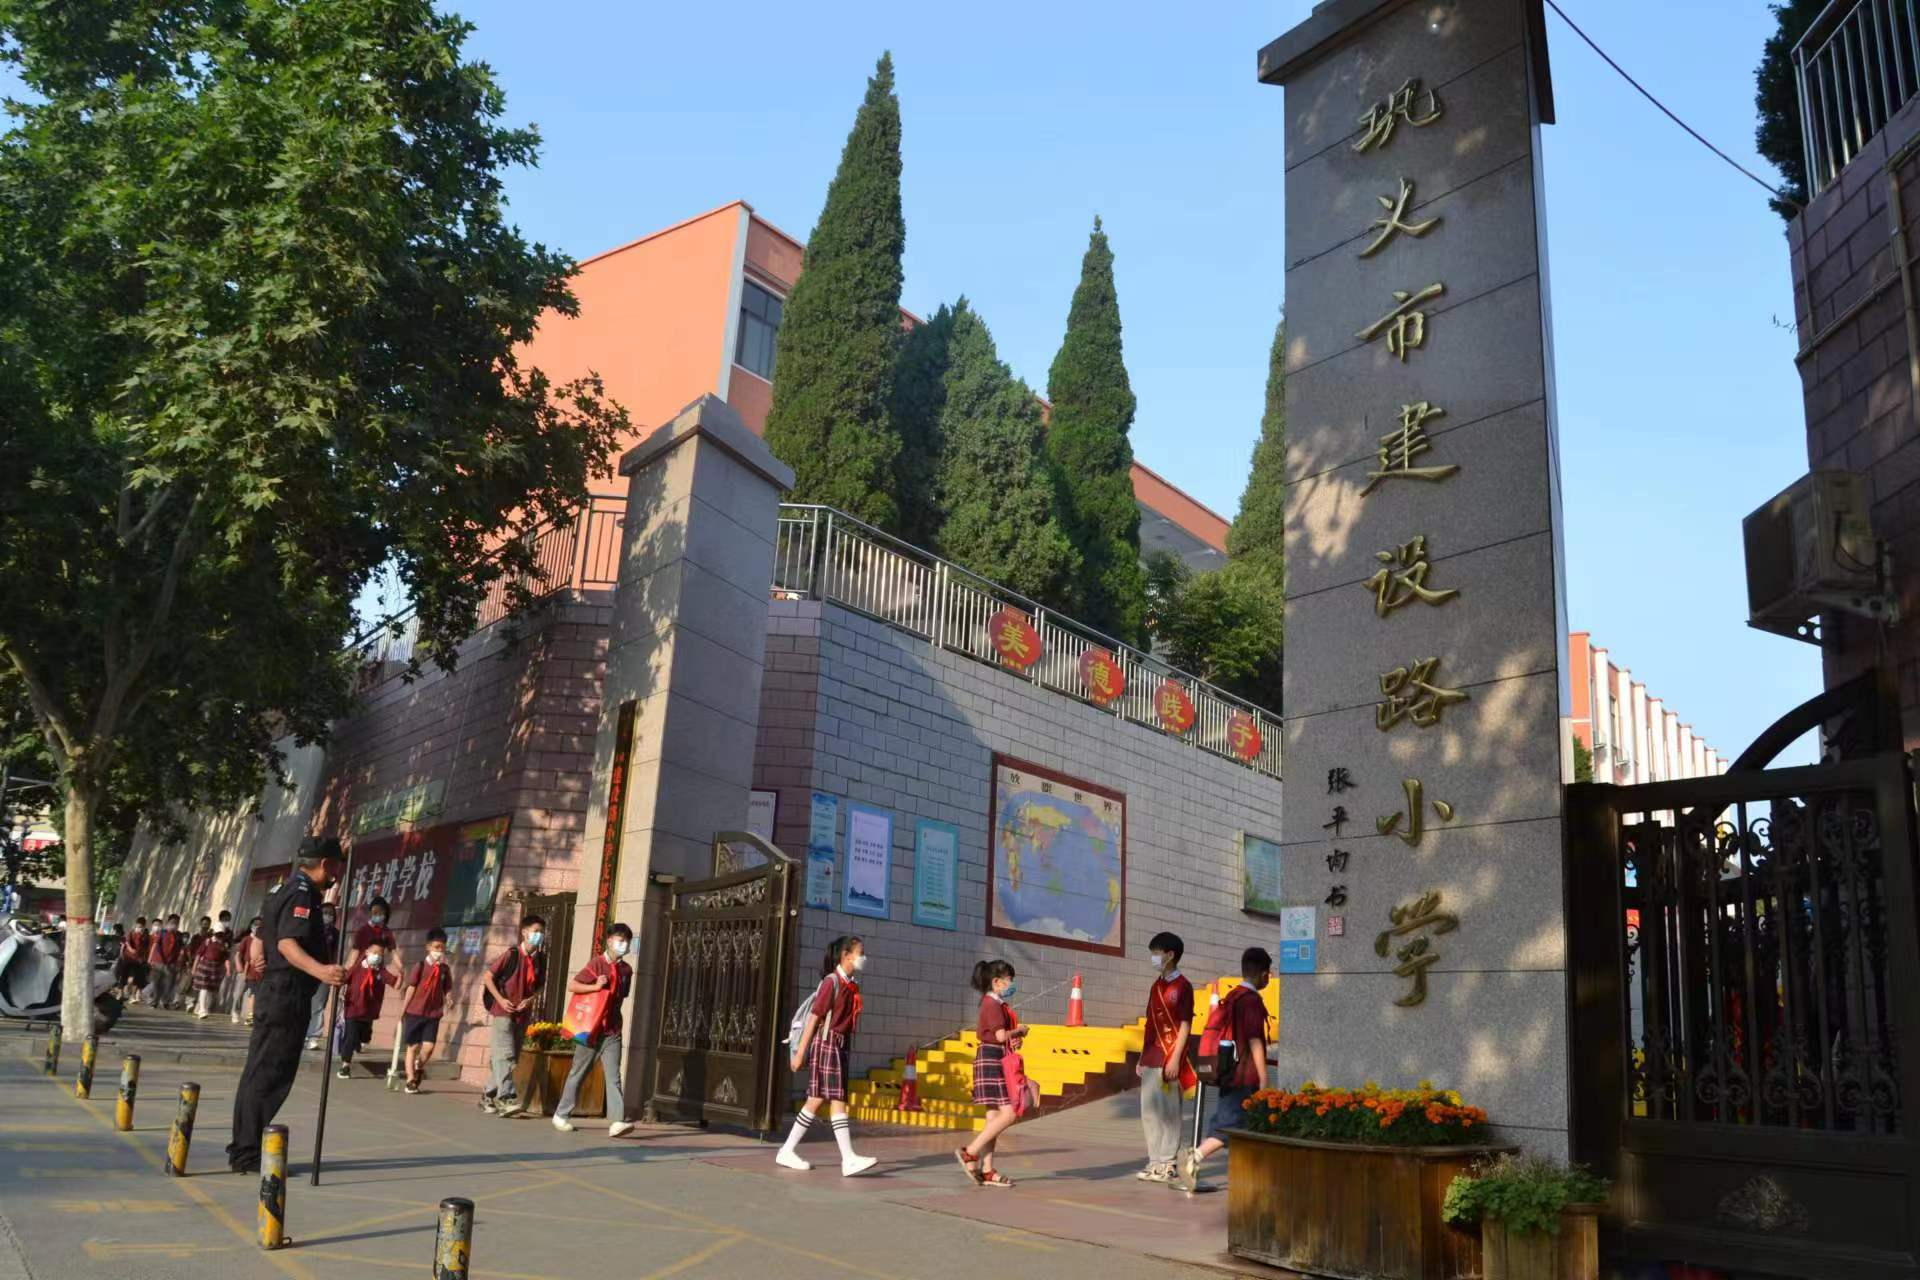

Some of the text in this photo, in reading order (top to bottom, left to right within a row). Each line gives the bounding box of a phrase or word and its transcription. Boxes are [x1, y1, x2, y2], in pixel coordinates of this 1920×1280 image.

[1351, 76, 1470, 1006] 巩义市建设路小学
[997, 621, 1031, 658] 美
[1087, 659, 1114, 694] 德
[1160, 692, 1185, 723] 践
[335, 850, 437, 909] 活走进学校
